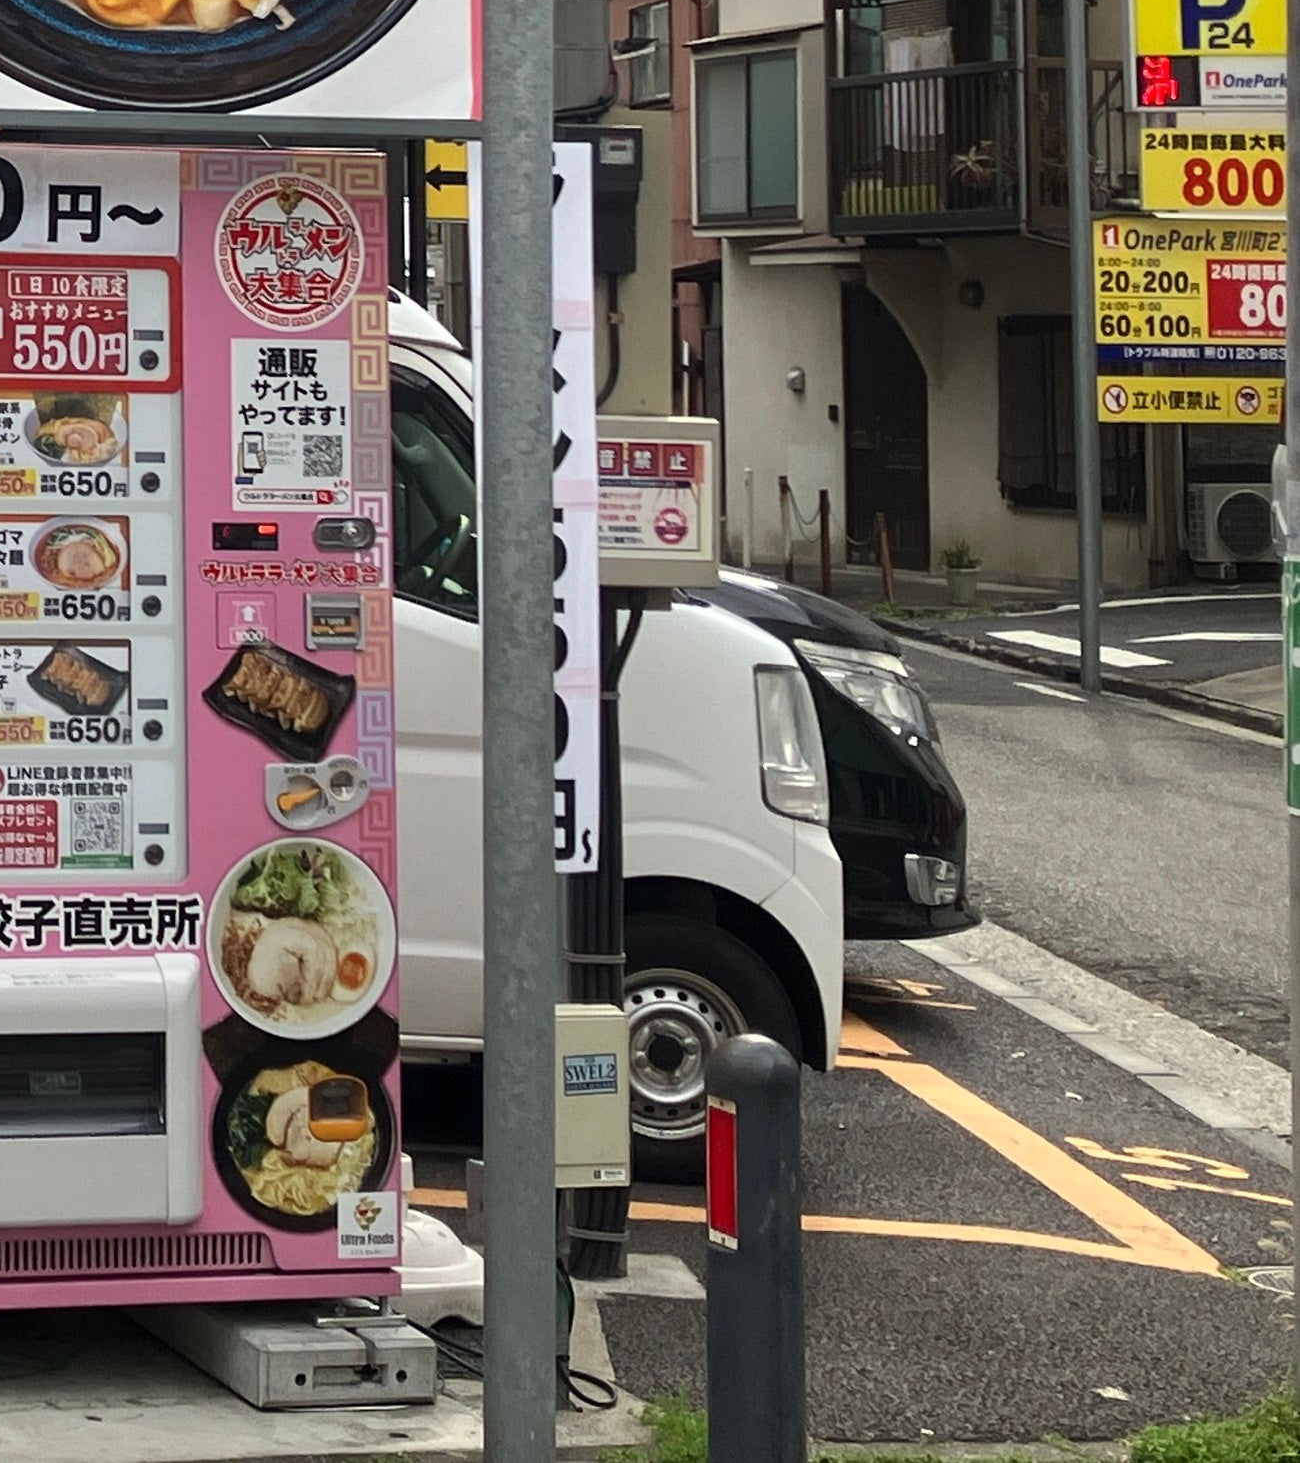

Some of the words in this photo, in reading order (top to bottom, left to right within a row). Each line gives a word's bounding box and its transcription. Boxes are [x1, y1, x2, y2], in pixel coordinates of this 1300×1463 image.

[1208, 22, 1255, 50] 24
[1182, 157, 1284, 207] 800
[1124, 228, 1216, 251] OnePark
[249, 270, 334, 302] 大集合
[9, 300, 128, 321] おすすめメニュー
[13, 324, 127, 373] 550円
[258, 347, 318, 378] 通販
[251, 379, 328, 402] サイトも
[1132, 390, 1222, 411] 立小便禁止
[58, 471, 128, 498] 650円
[62, 594, 131, 621] 650円
